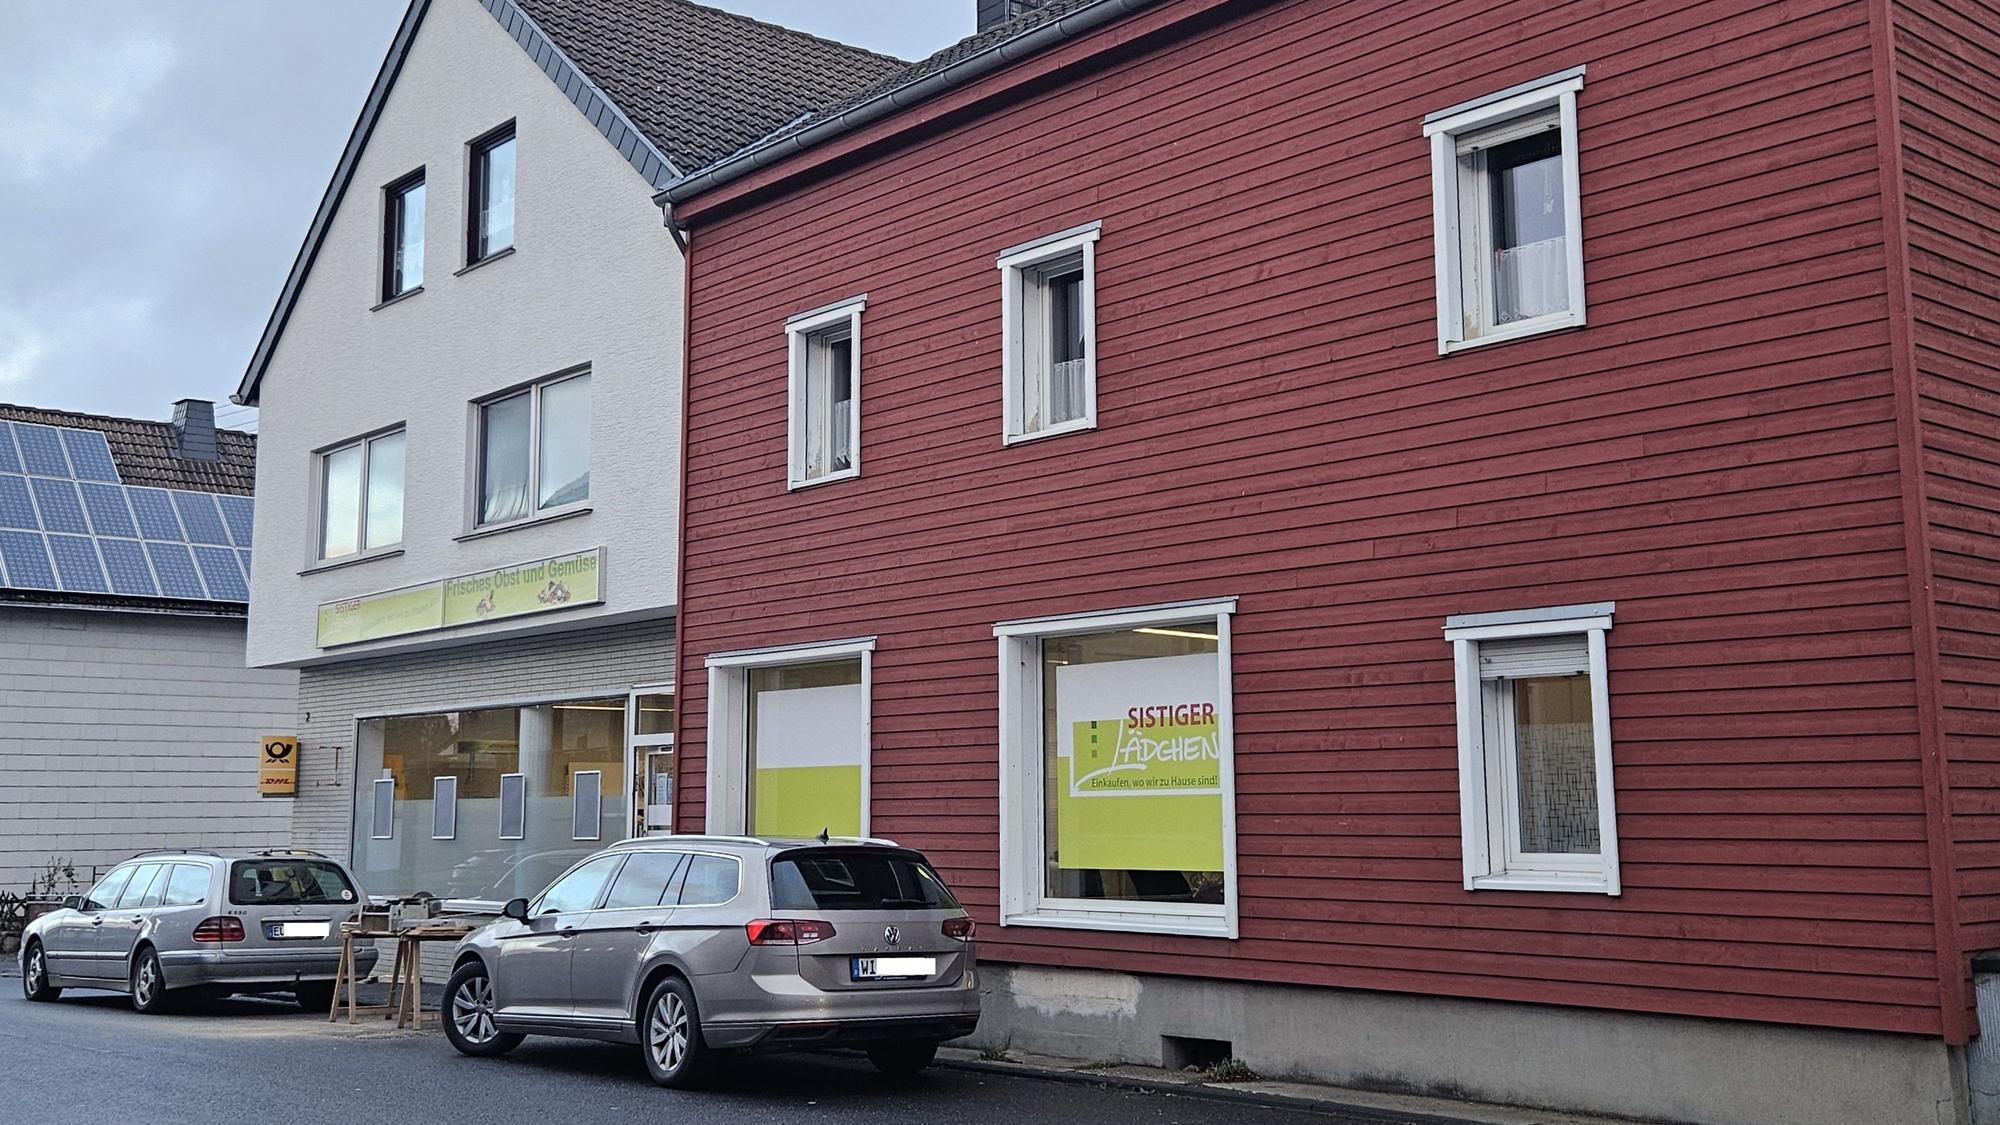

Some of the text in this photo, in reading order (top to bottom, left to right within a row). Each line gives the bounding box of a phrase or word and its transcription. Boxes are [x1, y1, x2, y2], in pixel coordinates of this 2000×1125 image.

[446, 555, 597, 597] Frisches Obst und Gemüse
[1128, 702, 1215, 729] SISTIGER
[1074, 719, 1219, 790] LÄDCHEN
[1092, 775, 1219, 788] Einkaufen, wo wir zu Hause sind!
[861, 960, 876, 975] WI
